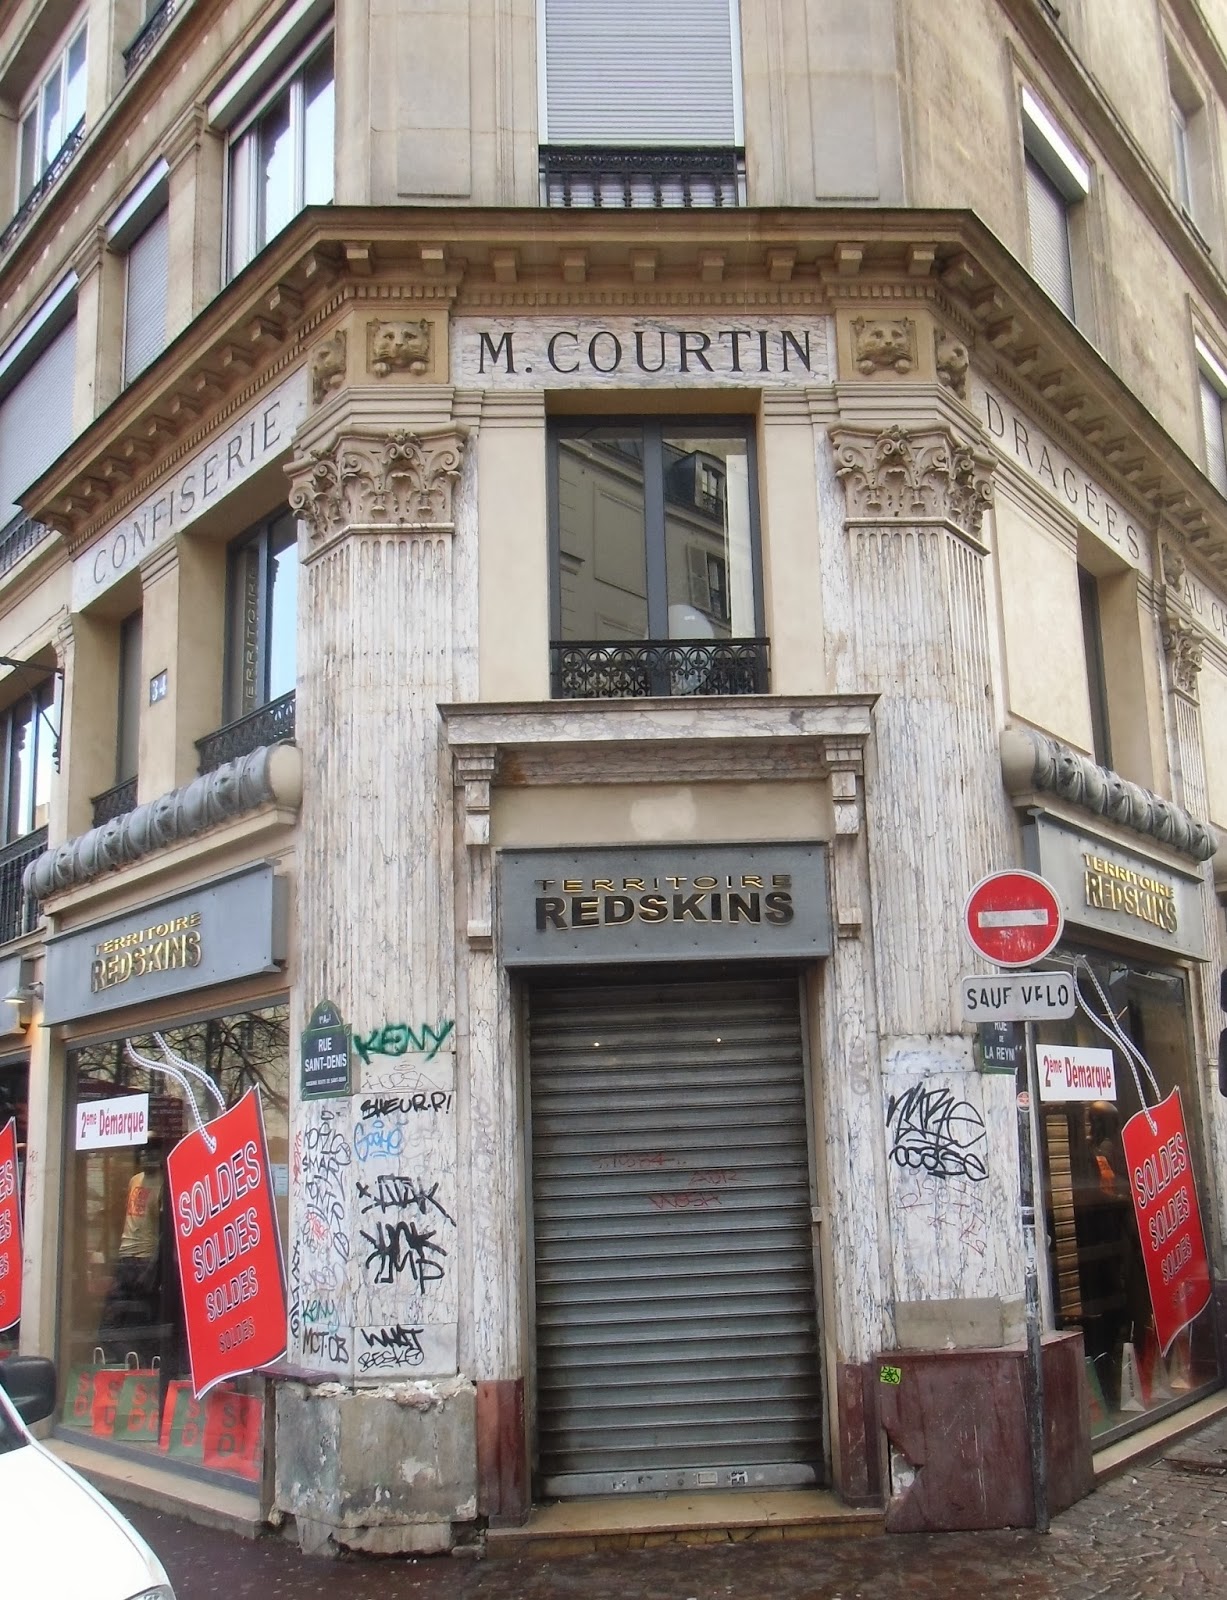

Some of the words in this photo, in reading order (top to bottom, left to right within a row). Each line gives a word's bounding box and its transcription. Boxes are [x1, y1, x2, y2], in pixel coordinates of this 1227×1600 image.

[478, 331, 533, 374] M.
[547, 330, 812, 374] COURTIN
[93, 401, 281, 584] CONFISERIE
[985, 391, 1140, 559] DRAGÉES
[1184, 576, 1203, 615] AU
[152, 674, 167, 701] 34
[534, 874, 793, 893] TERRITOIRE
[1083, 852, 1175, 900] TERRITOIRE
[535, 891, 795, 932] REDSKINS
[1084, 870, 1178, 934] REDSKINS
[91, 911, 202, 957] TERRITOIRE
[91, 930, 202, 993] REDSKINS
[304, 1053, 347, 1073] SAINT-DENIS
[318, 1037, 332, 1053] RUE
[984, 1045, 994, 1060] LA
[996, 1046, 1016, 1061] REYN
[1064, 1056, 1112, 1096] Démarque
[99, 1107, 145, 1141] Démarque
[179, 1140, 261, 1238] SOLDES
[1134, 1131, 1187, 1210] SOLDES
[1149, 1185, 1190, 1252] SOLDES
[193, 1206, 260, 1283] SOLDES
[1160, 1233, 1192, 1286] SOLDES
[205, 1265, 259, 1323] SOLDES
[219, 1316, 256, 1354] SOLDES
